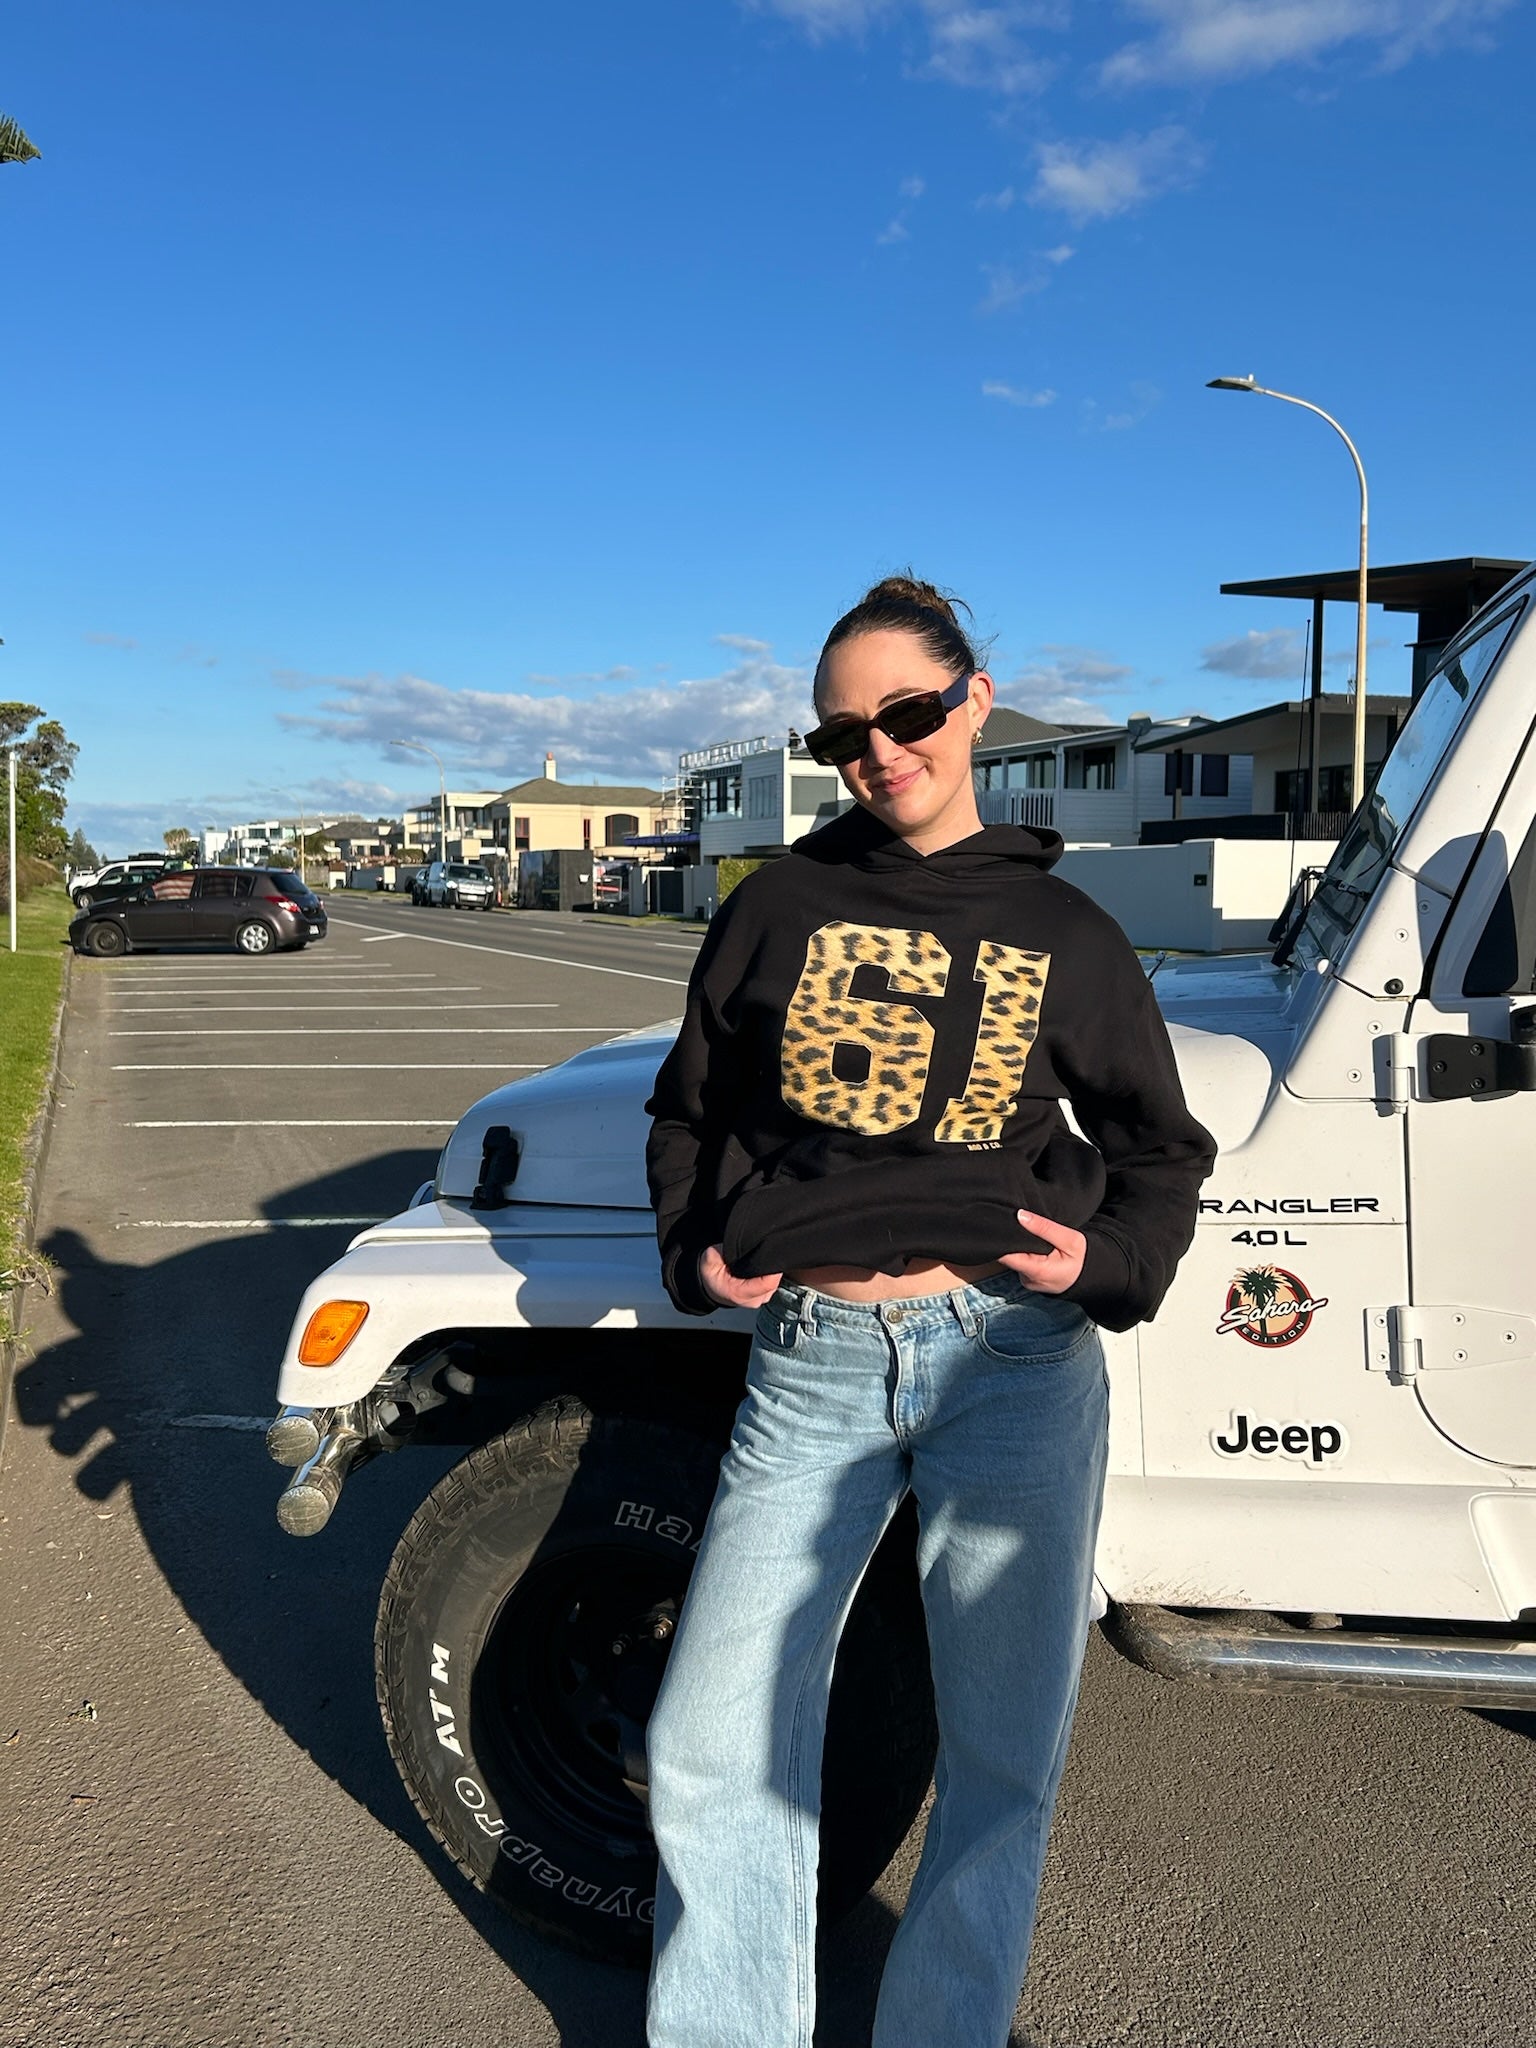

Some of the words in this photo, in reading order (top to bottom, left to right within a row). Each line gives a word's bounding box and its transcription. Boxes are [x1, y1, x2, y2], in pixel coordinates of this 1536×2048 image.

[780, 919, 1051, 1142] 61
[1199, 1197, 1380, 1214] RANGLER
[1216, 1296, 1328, 1335] Sahara
[1241, 1321, 1305, 1343] EDITION
[1216, 1415, 1342, 1462] Jeep
